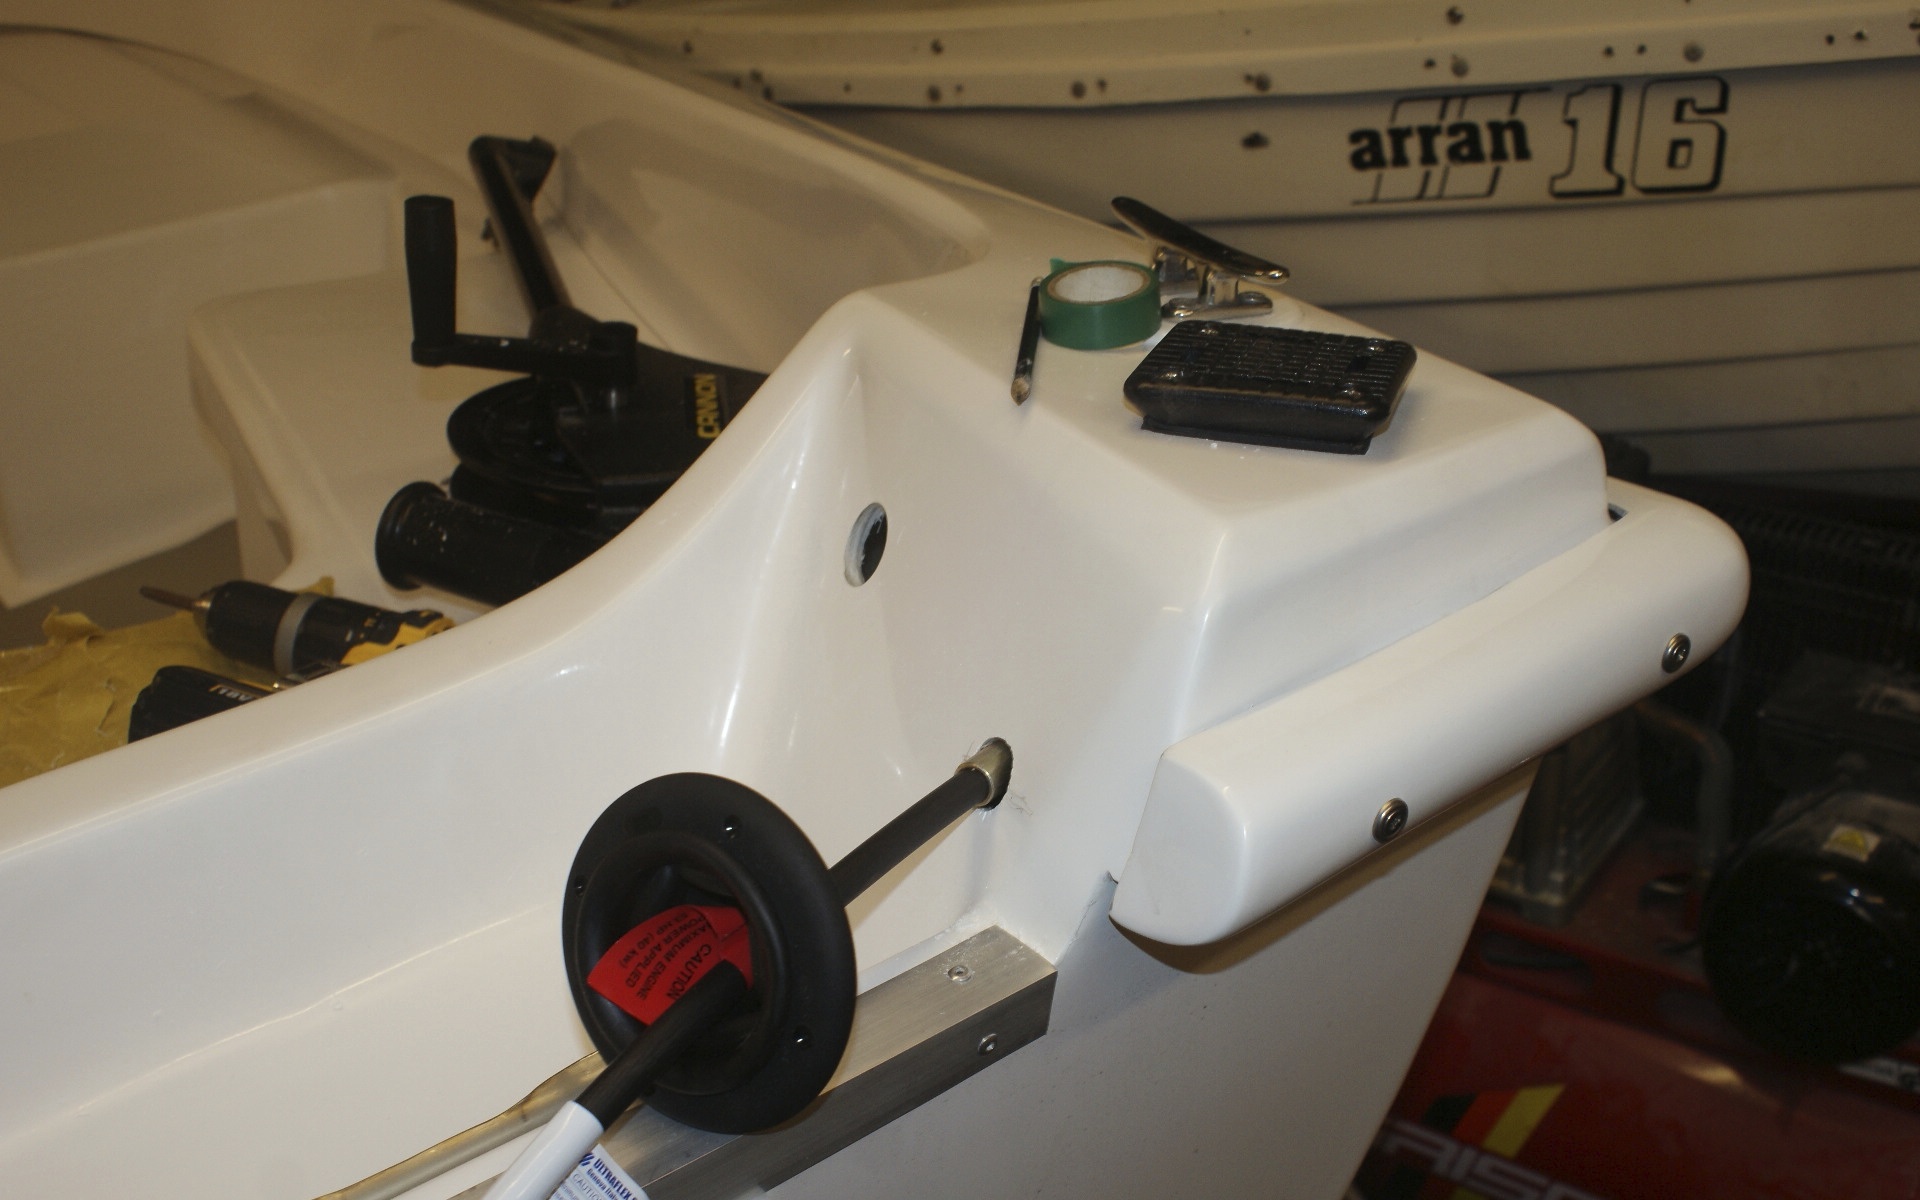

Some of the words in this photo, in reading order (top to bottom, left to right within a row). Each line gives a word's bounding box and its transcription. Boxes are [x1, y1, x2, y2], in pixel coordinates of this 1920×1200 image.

[1348, 118, 1532, 171] arran
[1548, 75, 1730, 199] 16
[695, 373, 720, 439] CANNON
[664, 915, 706, 945] POWER
[625, 943, 663, 989] APPLIED
[636, 963, 667, 1001] ENGINE
[666, 944, 712, 1001] CAUTION
[587, 1168, 607, 1191] Genova
[593, 1158, 632, 1200] ULTRAFLEX
